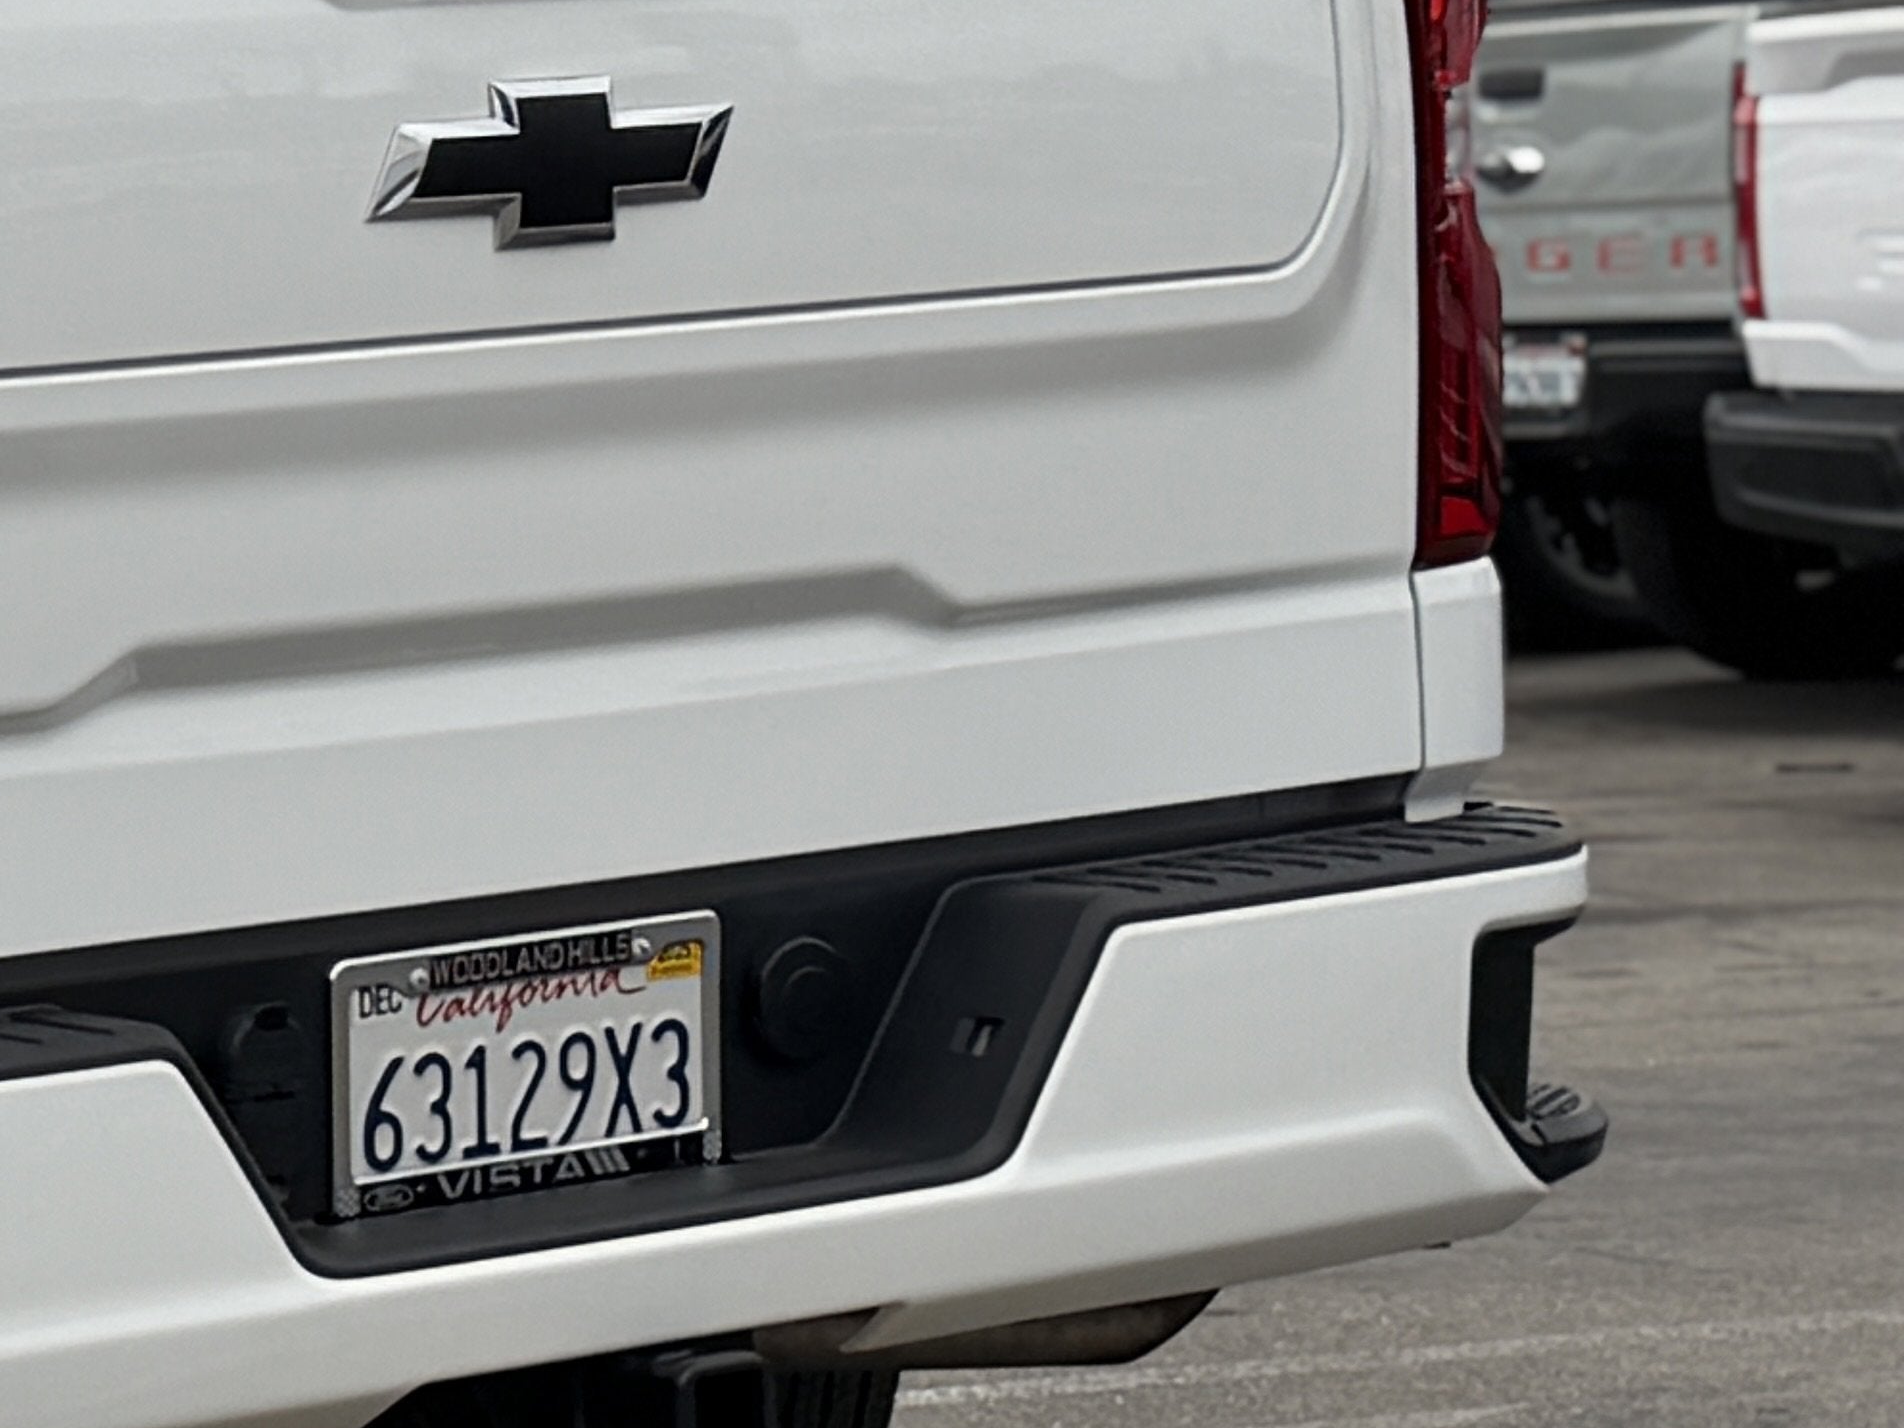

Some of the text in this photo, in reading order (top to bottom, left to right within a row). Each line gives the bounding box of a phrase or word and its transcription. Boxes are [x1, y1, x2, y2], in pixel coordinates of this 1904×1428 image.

[1494, 232, 1719, 275] GER
[432, 942, 564, 986] WOODLAND
[357, 982, 403, 1019] DEC
[363, 1018, 692, 1172] 63129X3
[436, 1152, 586, 1200] VISTA
